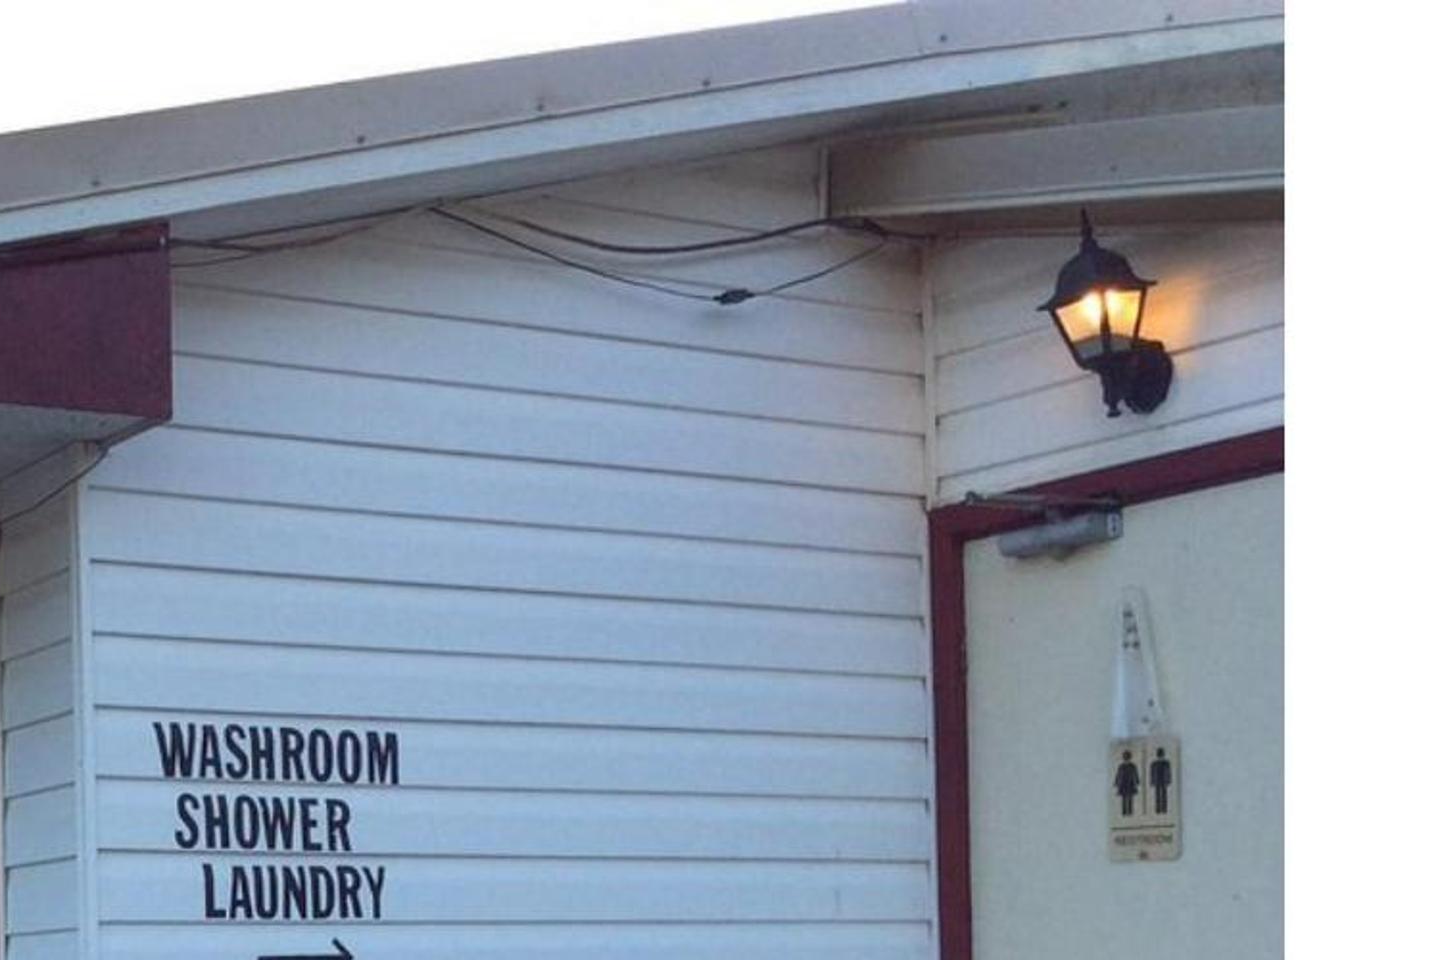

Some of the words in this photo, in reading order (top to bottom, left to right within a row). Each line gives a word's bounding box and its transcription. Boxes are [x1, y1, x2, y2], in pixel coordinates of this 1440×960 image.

[153, 722, 399, 785] WASHROOM
[174, 793, 351, 851] SHOWER
[202, 863, 385, 920] LAUNDRY
